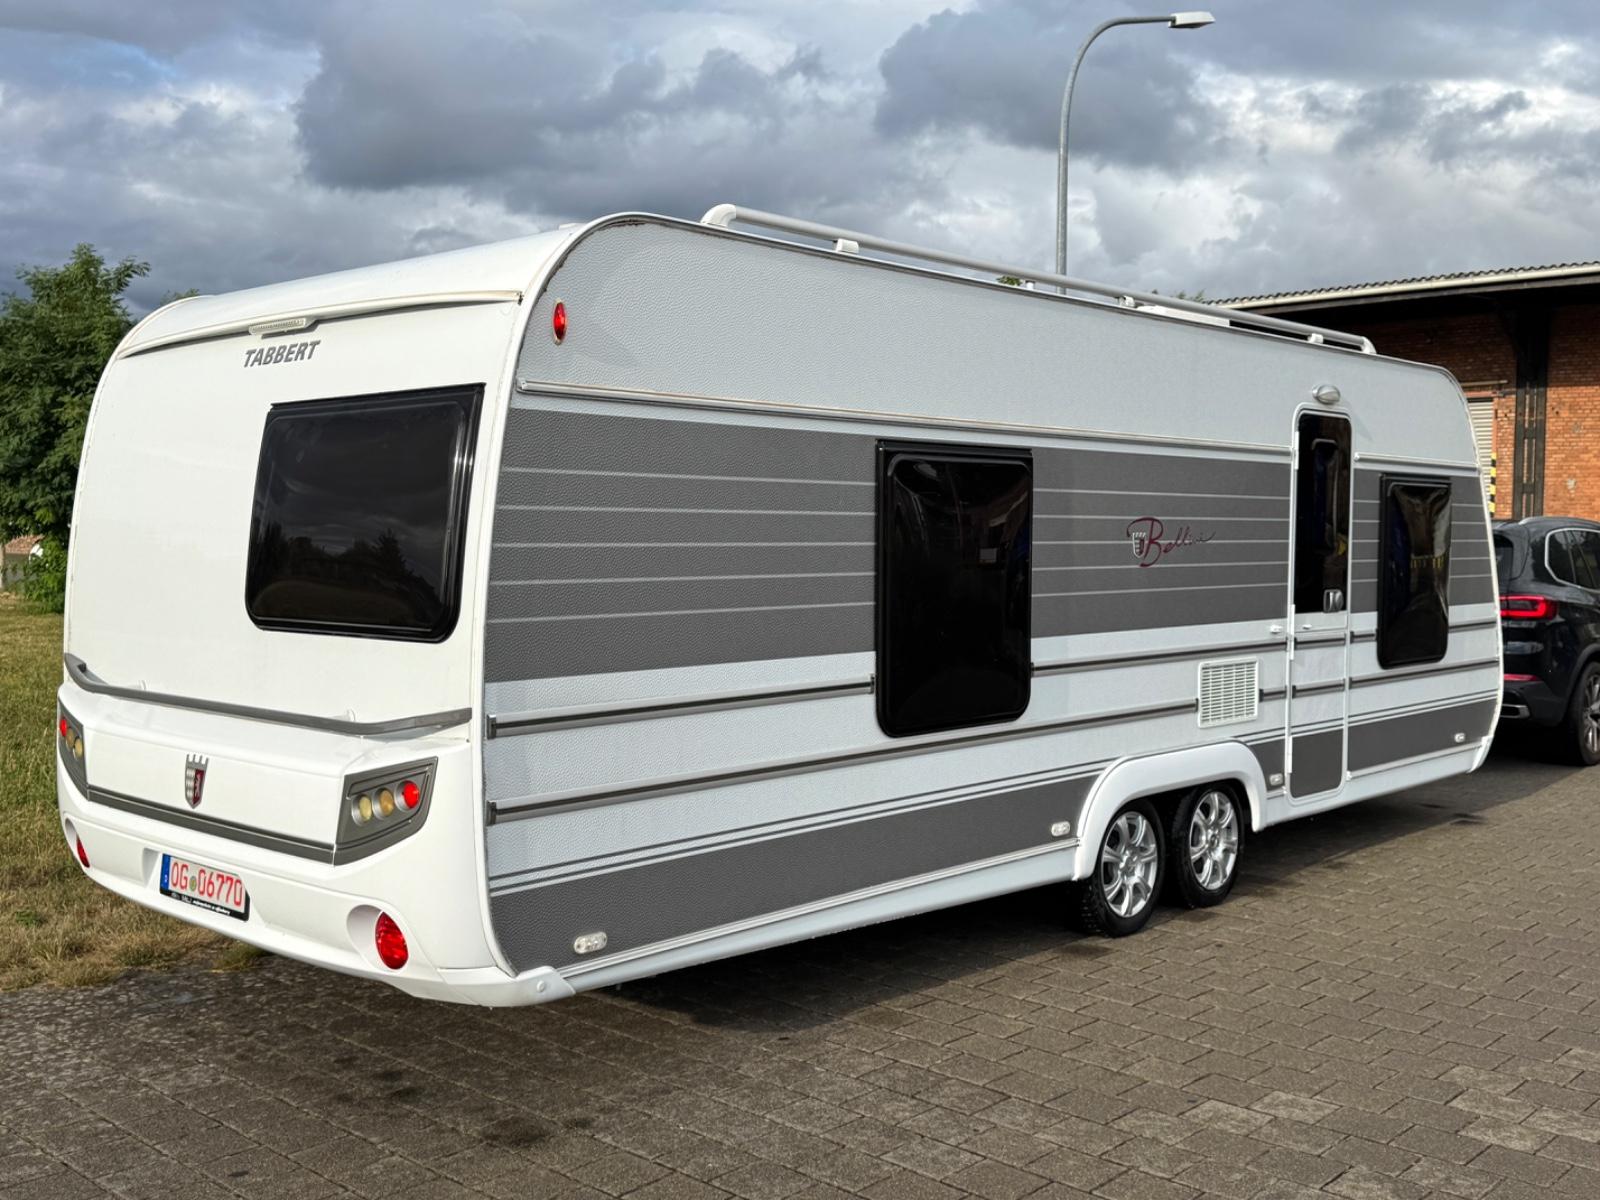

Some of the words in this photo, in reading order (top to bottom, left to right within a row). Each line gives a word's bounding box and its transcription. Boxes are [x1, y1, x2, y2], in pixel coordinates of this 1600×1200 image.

[244, 340, 321, 367] TABBERT
[171, 862, 189, 890] OG
[198, 868, 243, 907] 06770
